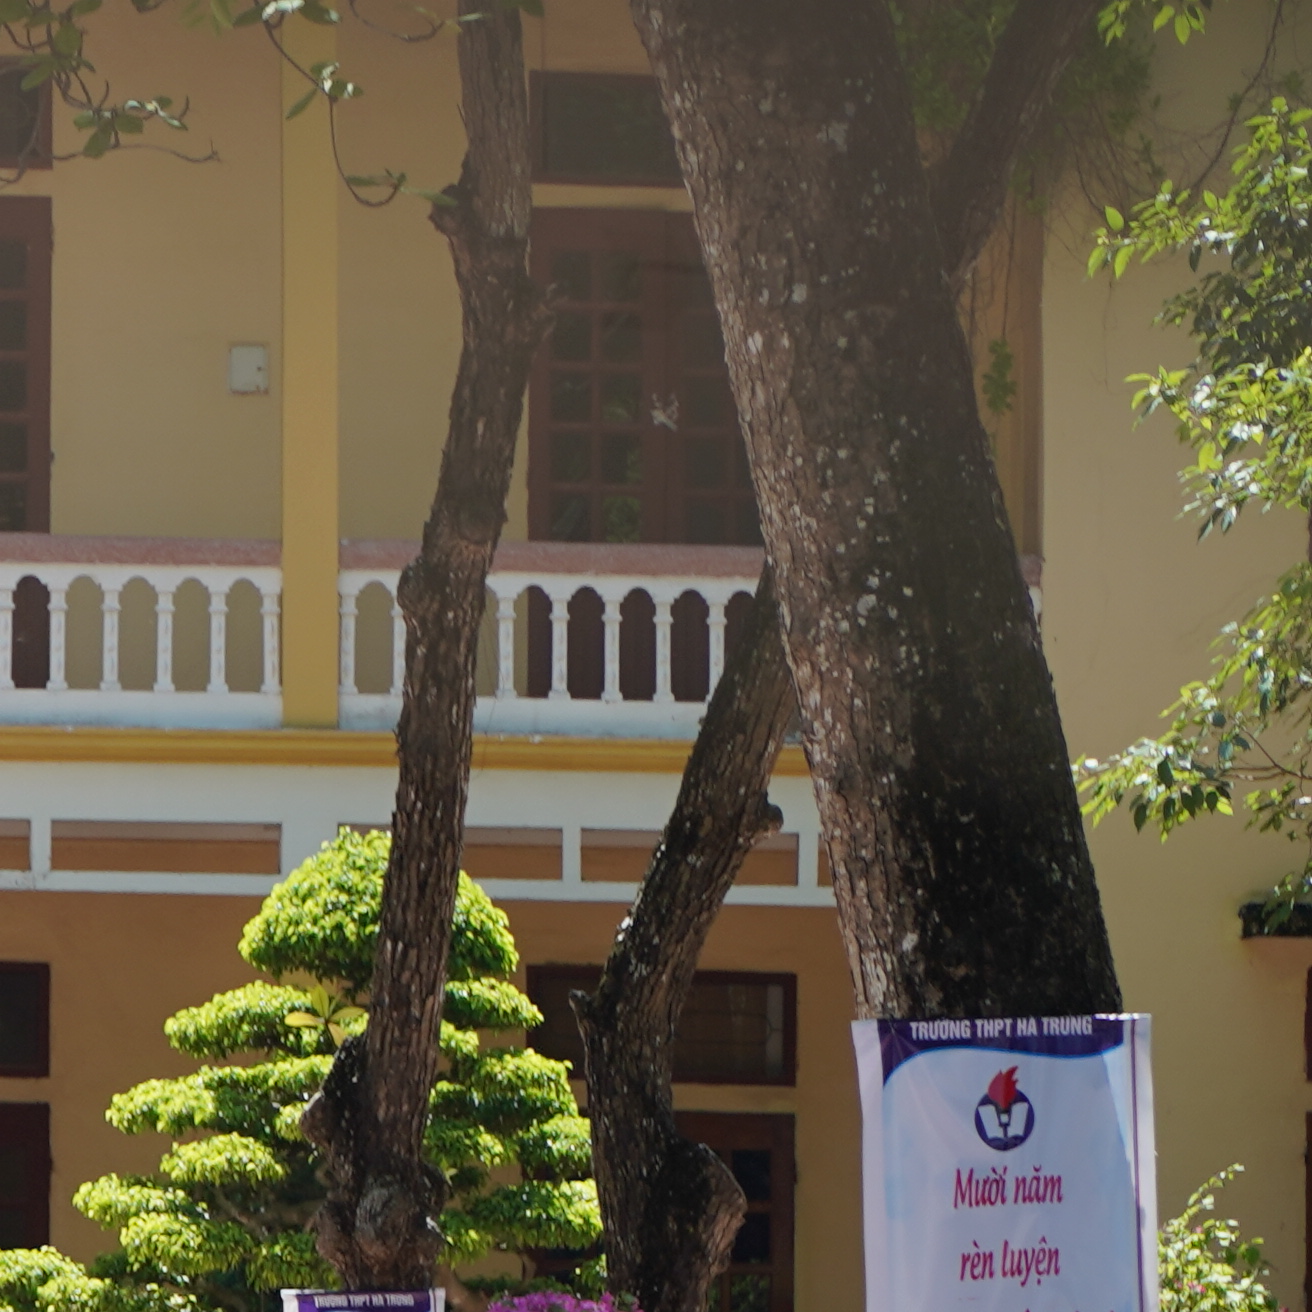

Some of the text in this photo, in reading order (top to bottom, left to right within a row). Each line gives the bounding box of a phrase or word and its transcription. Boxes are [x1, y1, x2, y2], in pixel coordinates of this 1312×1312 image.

[974, 1017, 1013, 1039] THPT
[1041, 1014, 1094, 1037] TRUNG
[953, 1164, 1064, 1209] Mười năm
[959, 1234, 1061, 1288] rèn luyện
